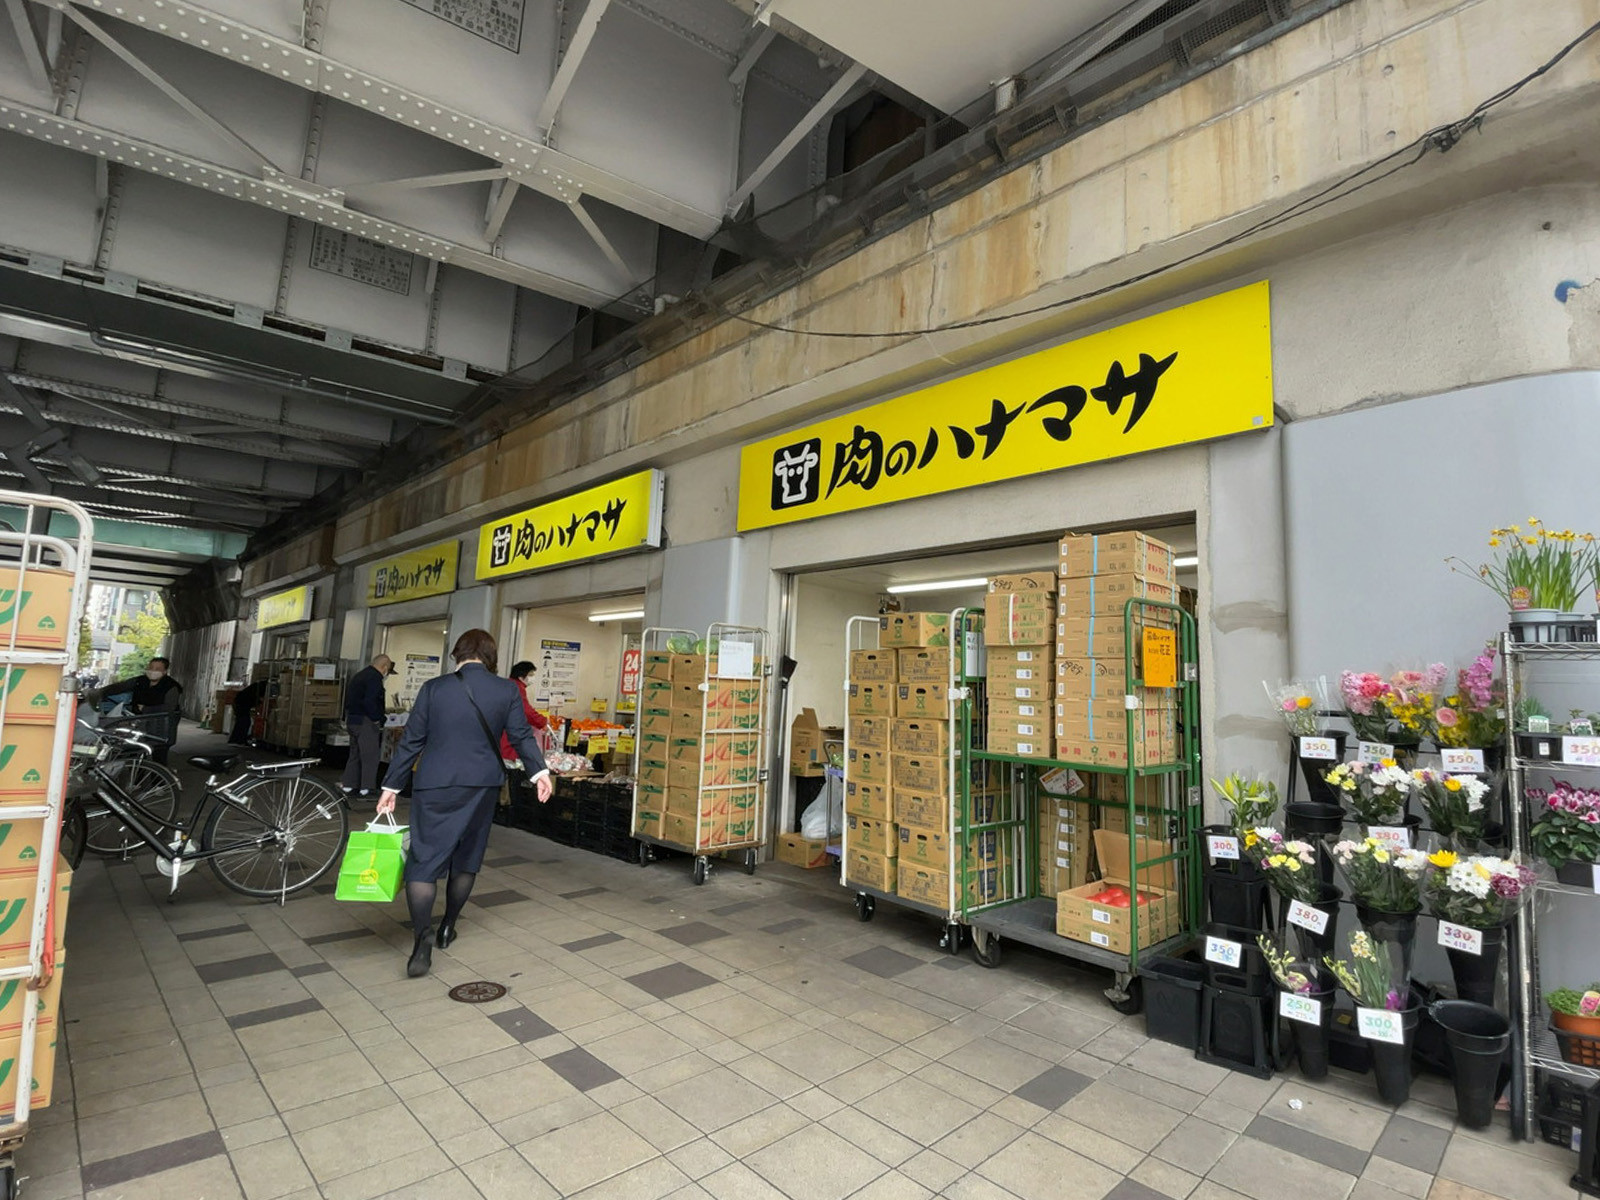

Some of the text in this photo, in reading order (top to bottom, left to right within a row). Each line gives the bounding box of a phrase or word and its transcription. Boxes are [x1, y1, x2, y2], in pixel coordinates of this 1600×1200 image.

[825, 351, 1178, 499] 肉のハナマサ
[511, 497, 627, 563] 肉のハナマサ
[387, 557, 446, 595] 肉のハナマサ
